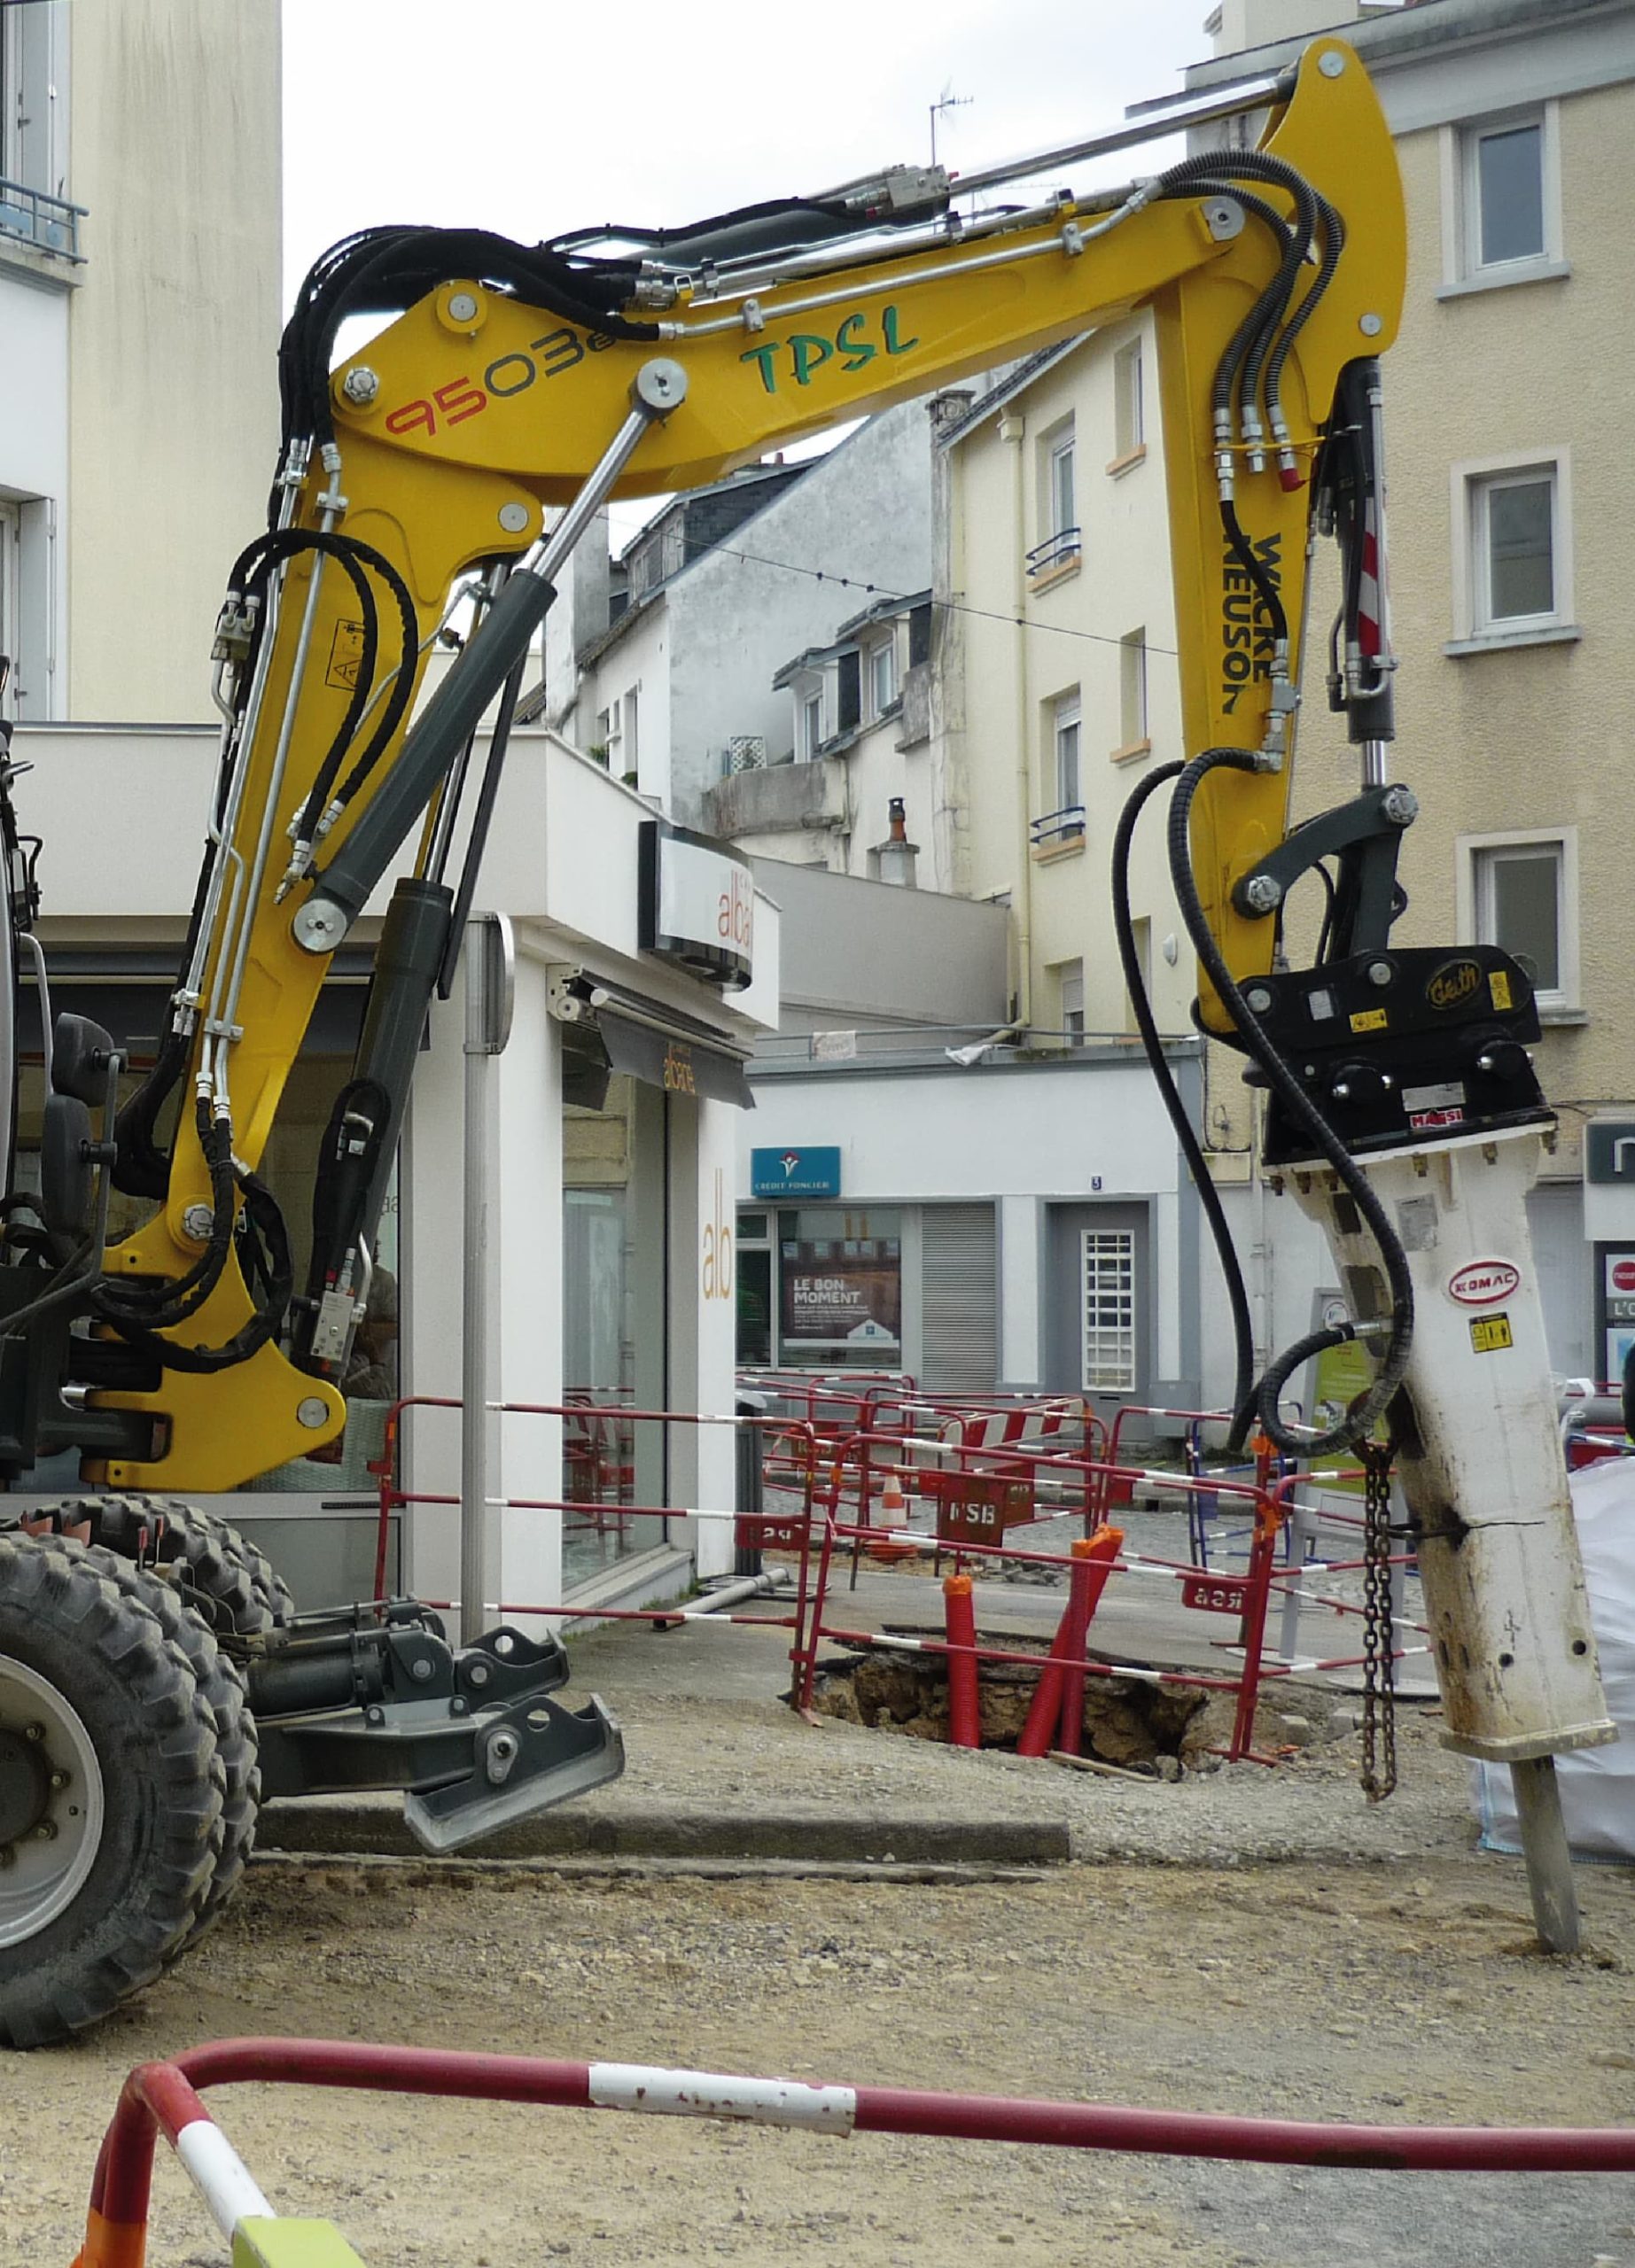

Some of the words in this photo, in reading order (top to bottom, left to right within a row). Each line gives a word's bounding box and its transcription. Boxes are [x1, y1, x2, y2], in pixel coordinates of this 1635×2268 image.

[740, 306, 919, 393] TPSL
[794, 1279, 810, 1291] LE
[814, 1278, 845, 1291] BON
[1455, 1272, 1514, 1293] KOMAC
[794, 1292, 860, 1304] MOMENT
